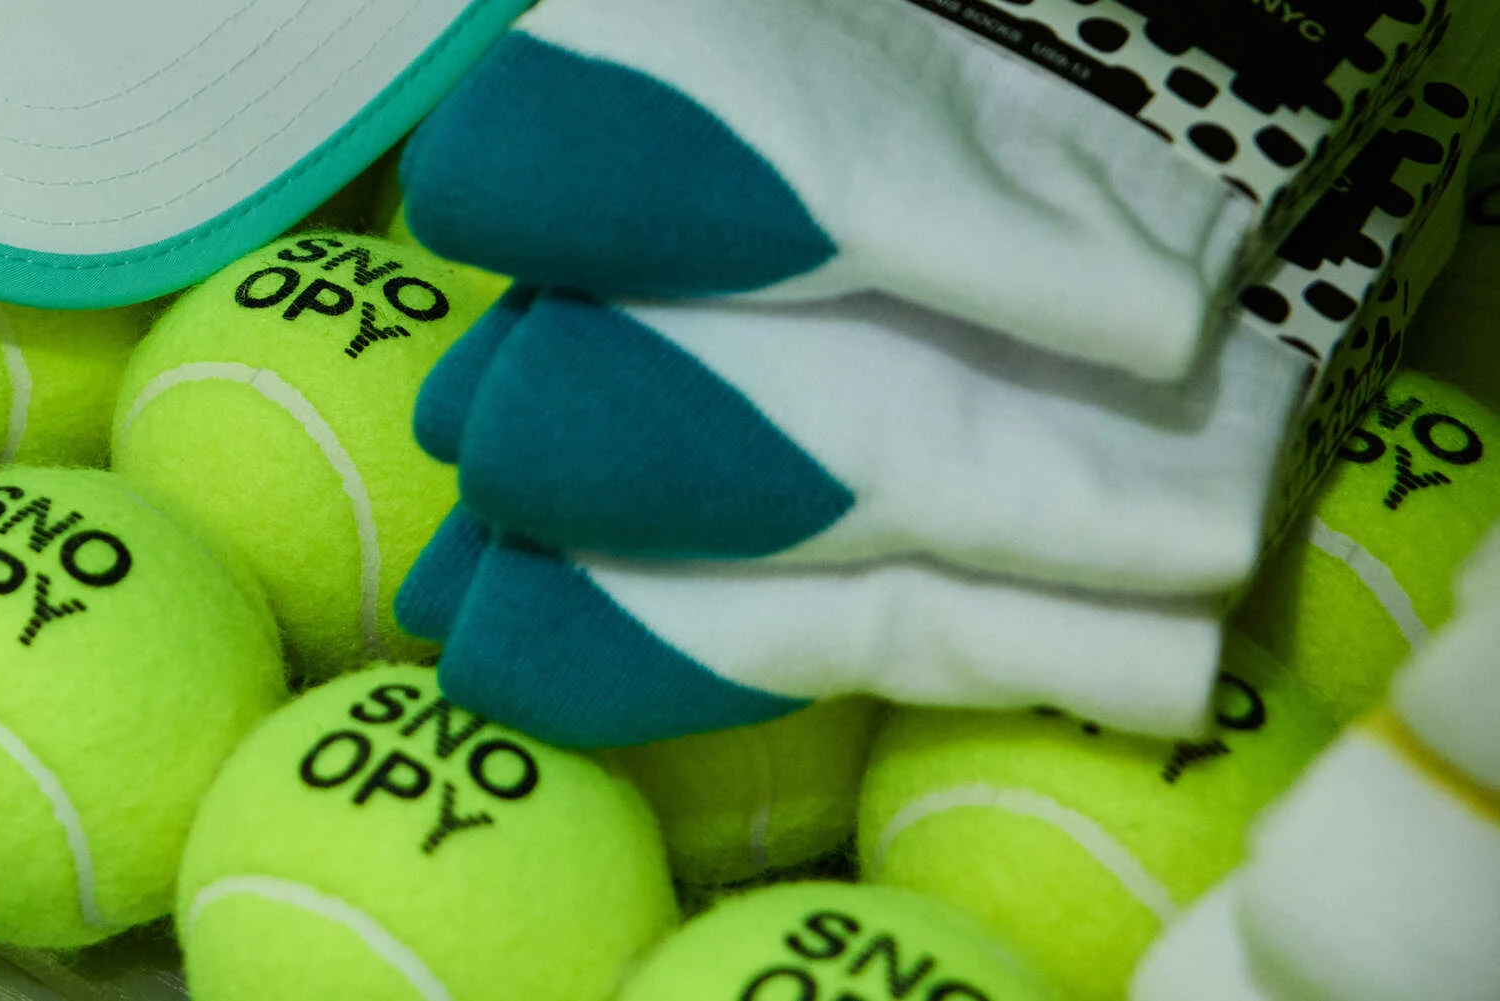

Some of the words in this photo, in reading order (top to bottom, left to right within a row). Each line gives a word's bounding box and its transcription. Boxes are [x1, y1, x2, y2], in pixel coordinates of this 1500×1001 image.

[235, 266, 411, 360] OPY
[276, 238, 450, 322] SNO
[1339, 428, 1451, 511] PY
[1378, 393, 1484, 465] NO
[349, 684, 539, 801] SNO
[300, 729, 495, 856] OPY
